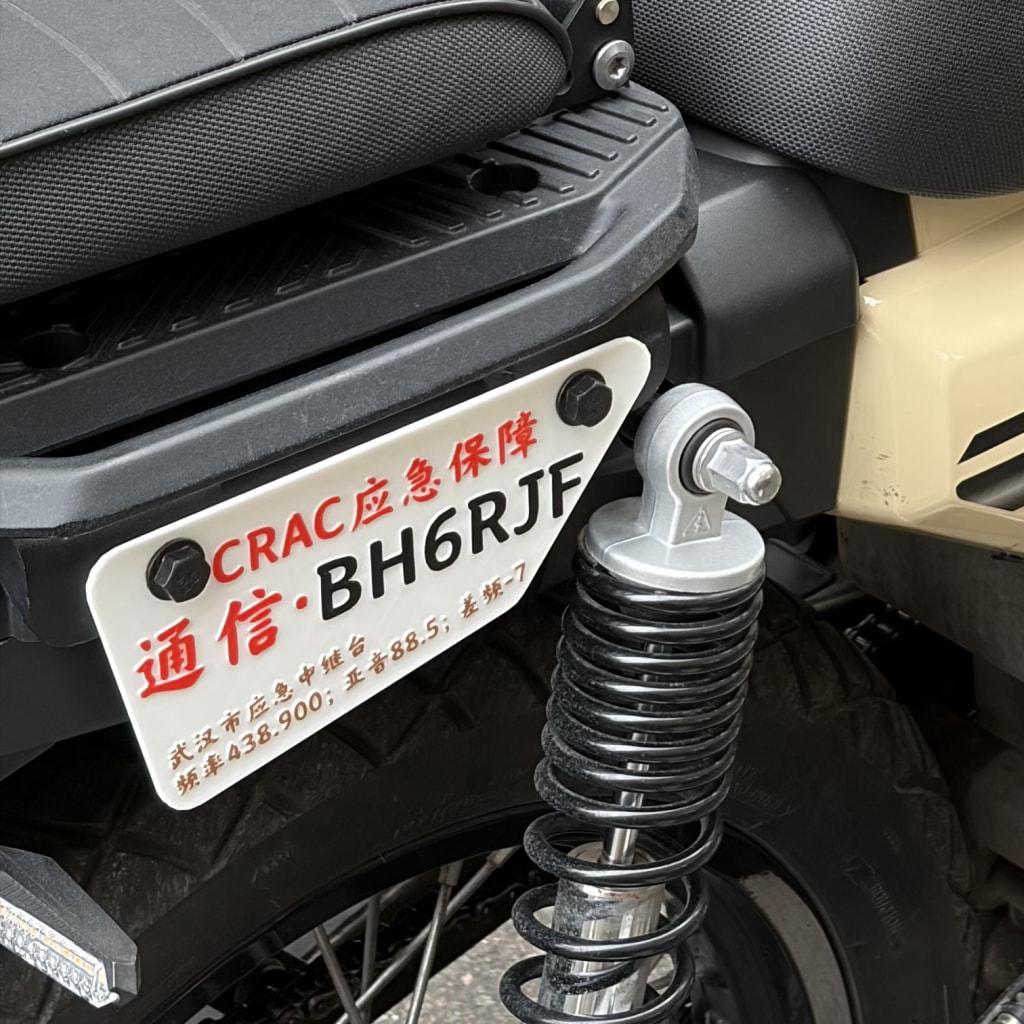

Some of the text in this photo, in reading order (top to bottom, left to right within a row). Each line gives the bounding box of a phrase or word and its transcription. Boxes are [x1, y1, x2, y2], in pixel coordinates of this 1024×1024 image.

[169, 635, 366, 771] 武汉市应急中继台
